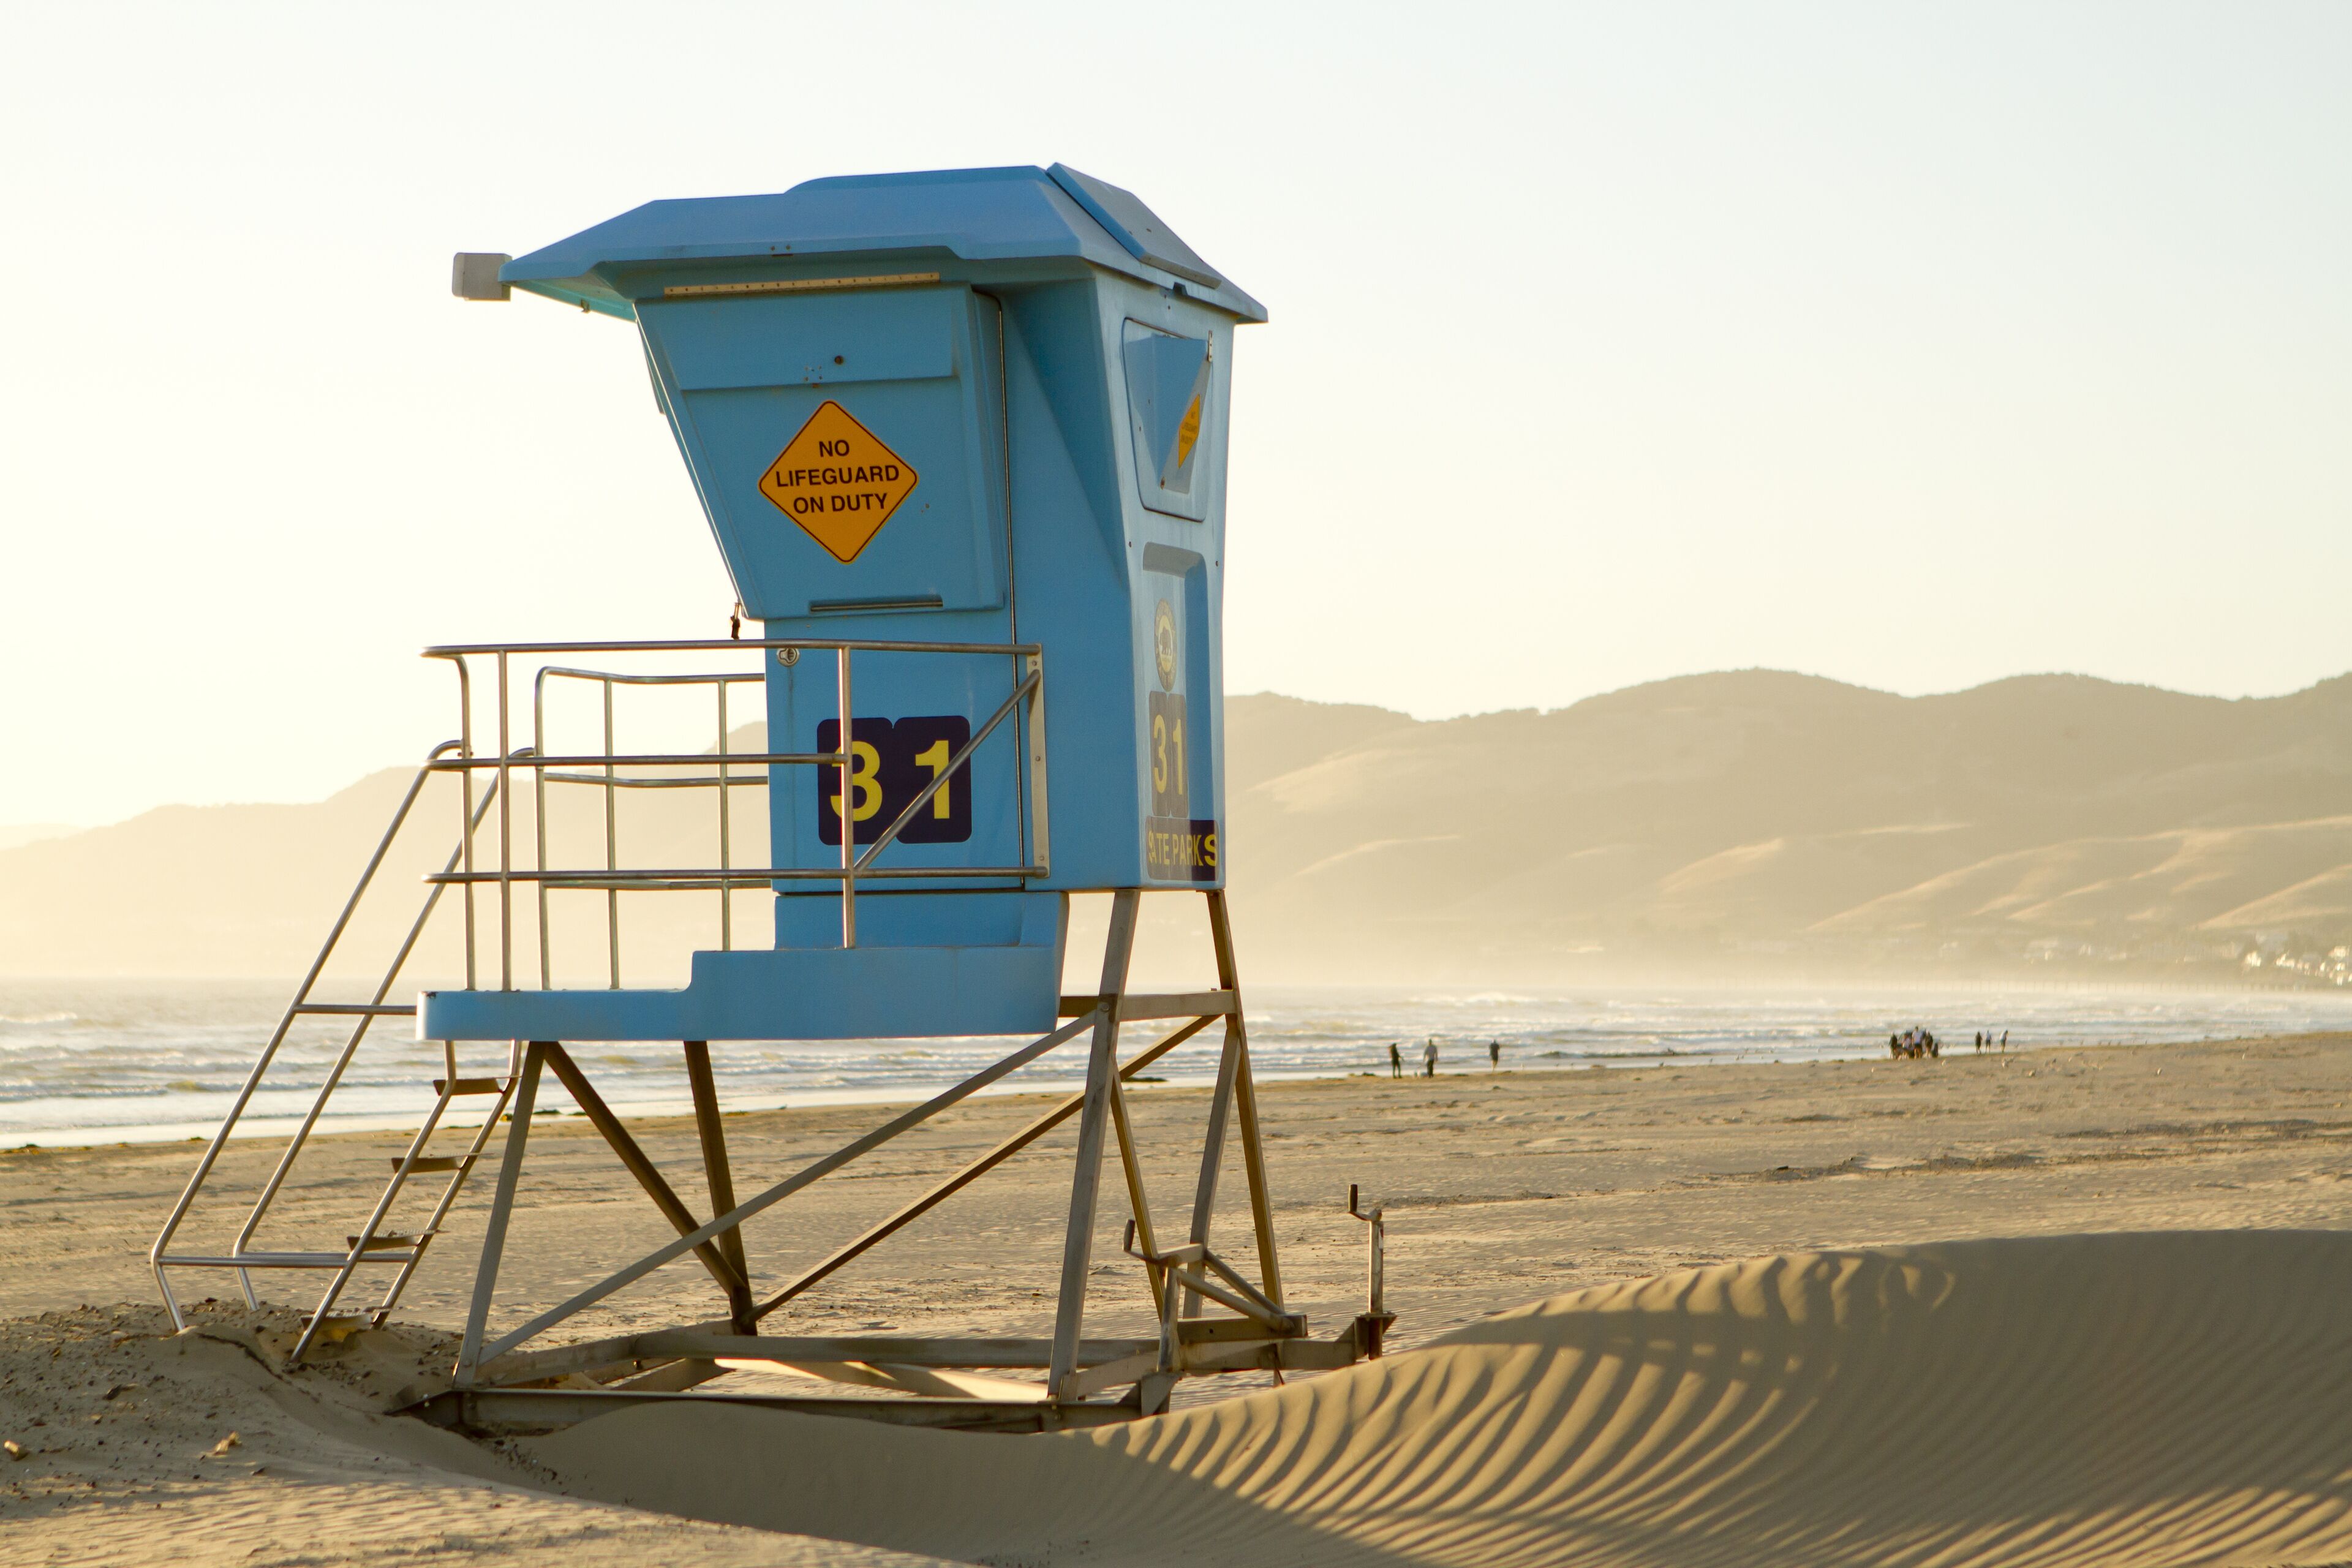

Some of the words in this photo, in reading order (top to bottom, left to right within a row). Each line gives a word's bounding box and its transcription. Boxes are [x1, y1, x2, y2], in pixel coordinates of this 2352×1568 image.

[819, 439, 850, 457] NO
[776, 465, 899, 487] LIFEGUARD
[793, 497, 824, 514] ON
[831, 493, 888, 512] DUTY
[1153, 714, 1183, 795] 31
[831, 740, 950, 821] 31
[1172, 834, 1217, 867] PARKS
